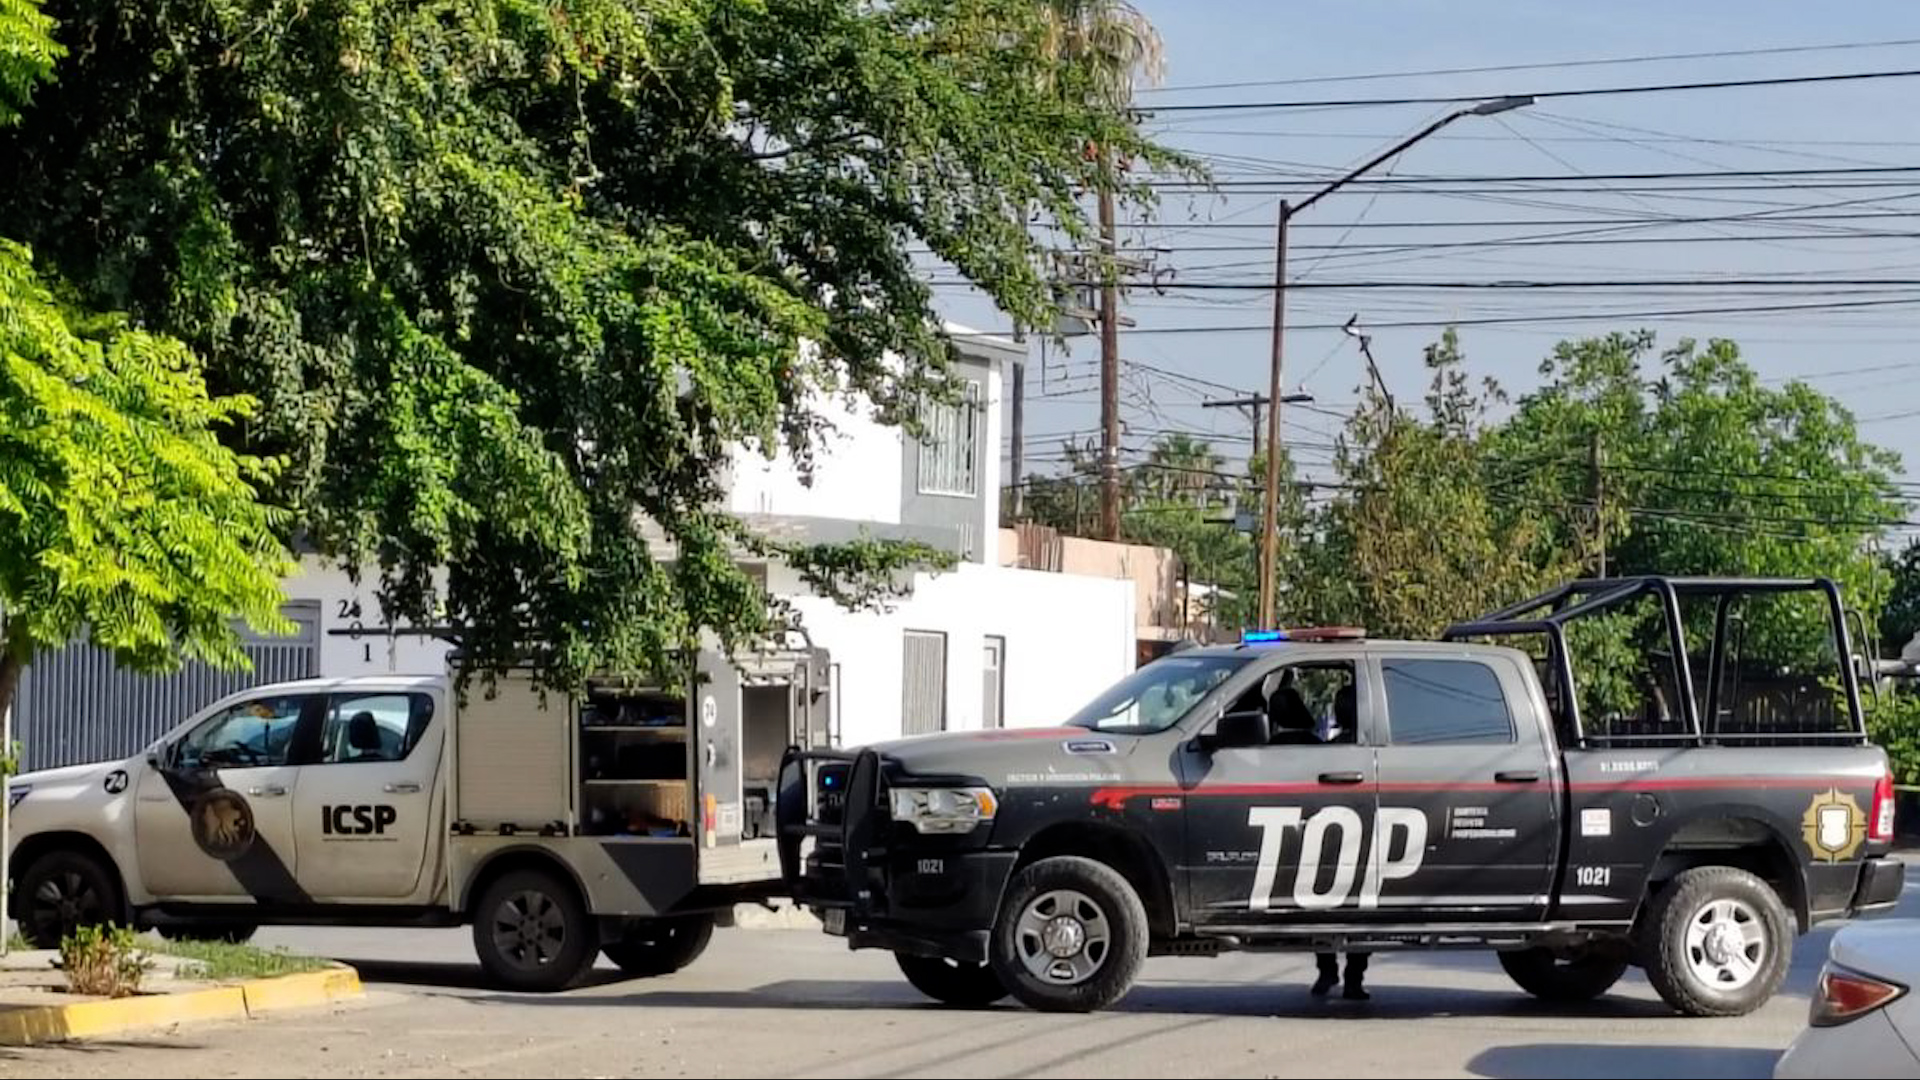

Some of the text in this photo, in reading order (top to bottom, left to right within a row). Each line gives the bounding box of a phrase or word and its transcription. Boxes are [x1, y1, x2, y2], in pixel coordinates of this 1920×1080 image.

[322, 805, 397, 834] ICSP
[917, 859, 944, 874] 1021
[1249, 805, 1428, 910] TOP
[1577, 867, 1611, 887] 1021
